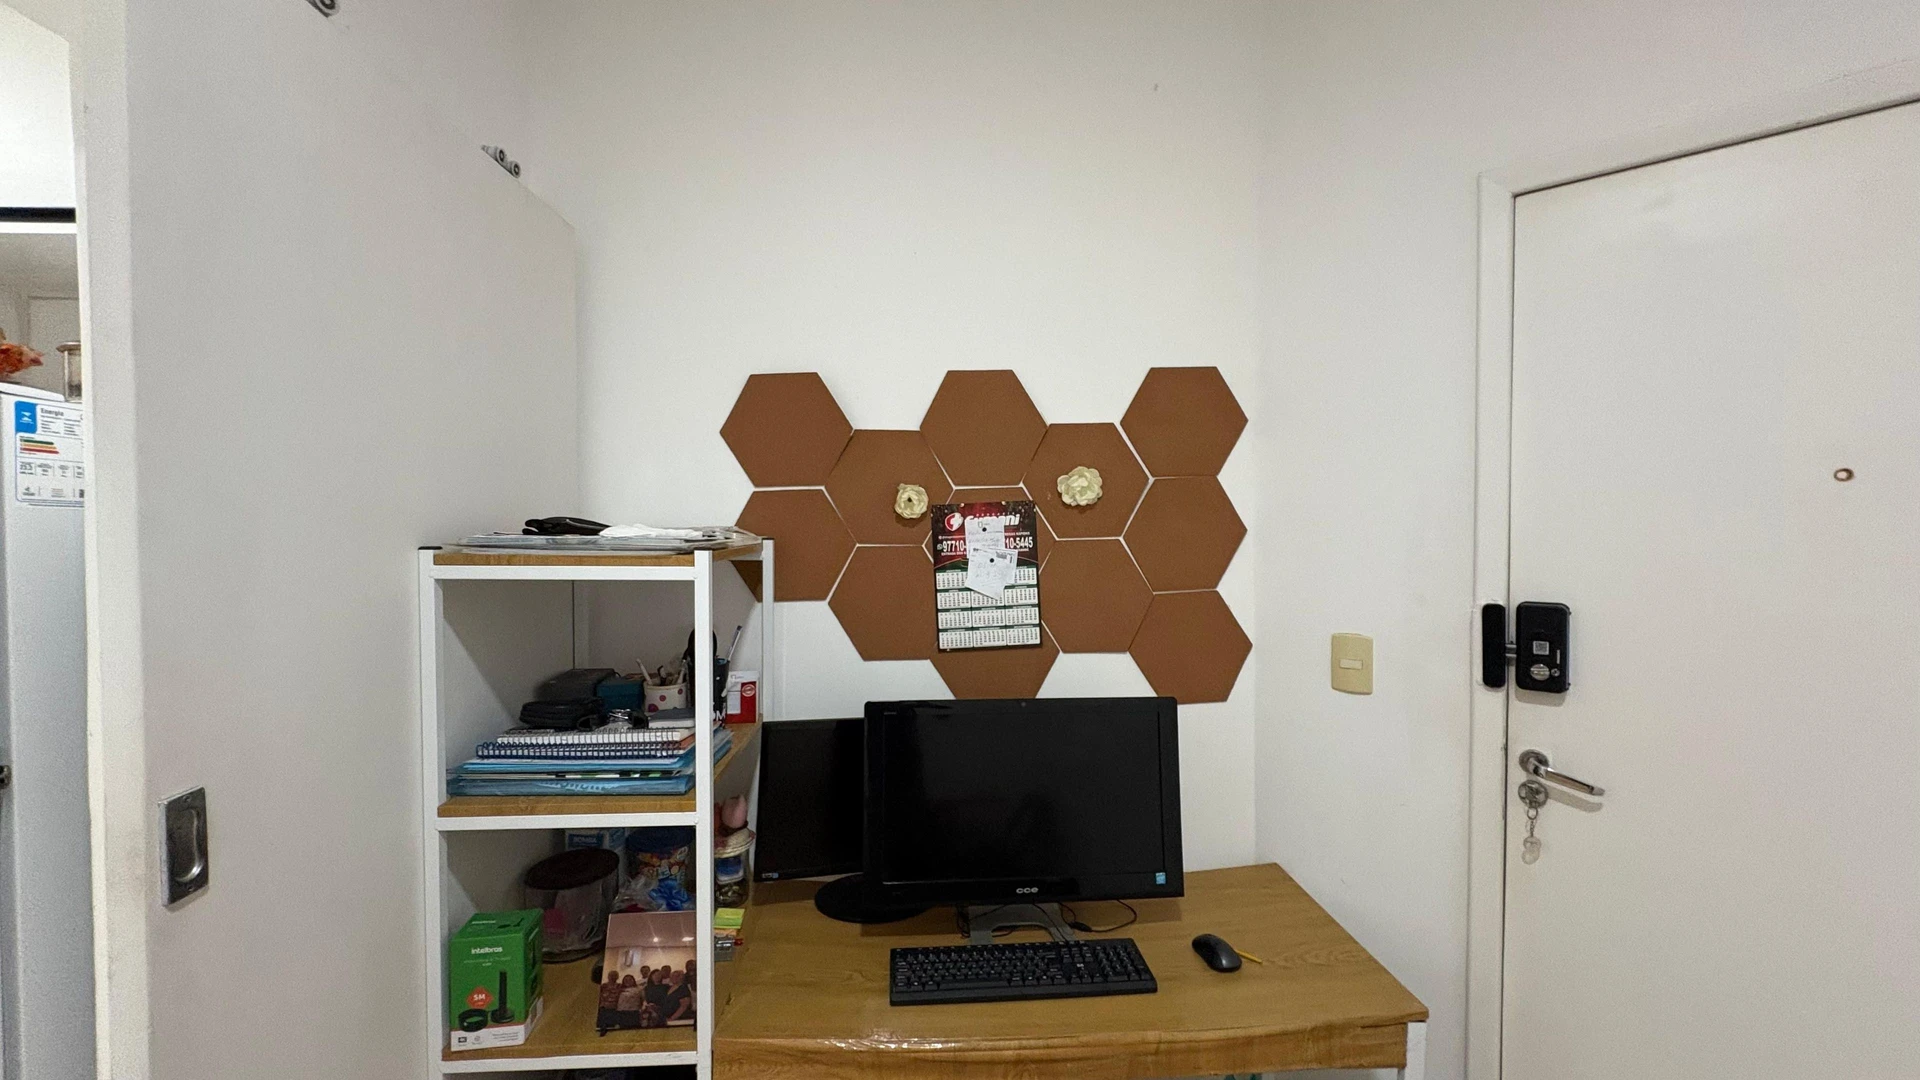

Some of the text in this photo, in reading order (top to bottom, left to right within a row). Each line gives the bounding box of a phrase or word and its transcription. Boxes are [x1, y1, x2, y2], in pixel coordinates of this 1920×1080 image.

[40, 407, 64, 416] Energia
[943, 540, 967, 552] 97710-
[1005, 536, 1034, 549] 10-5445
[471, 946, 503, 955] intelbras
